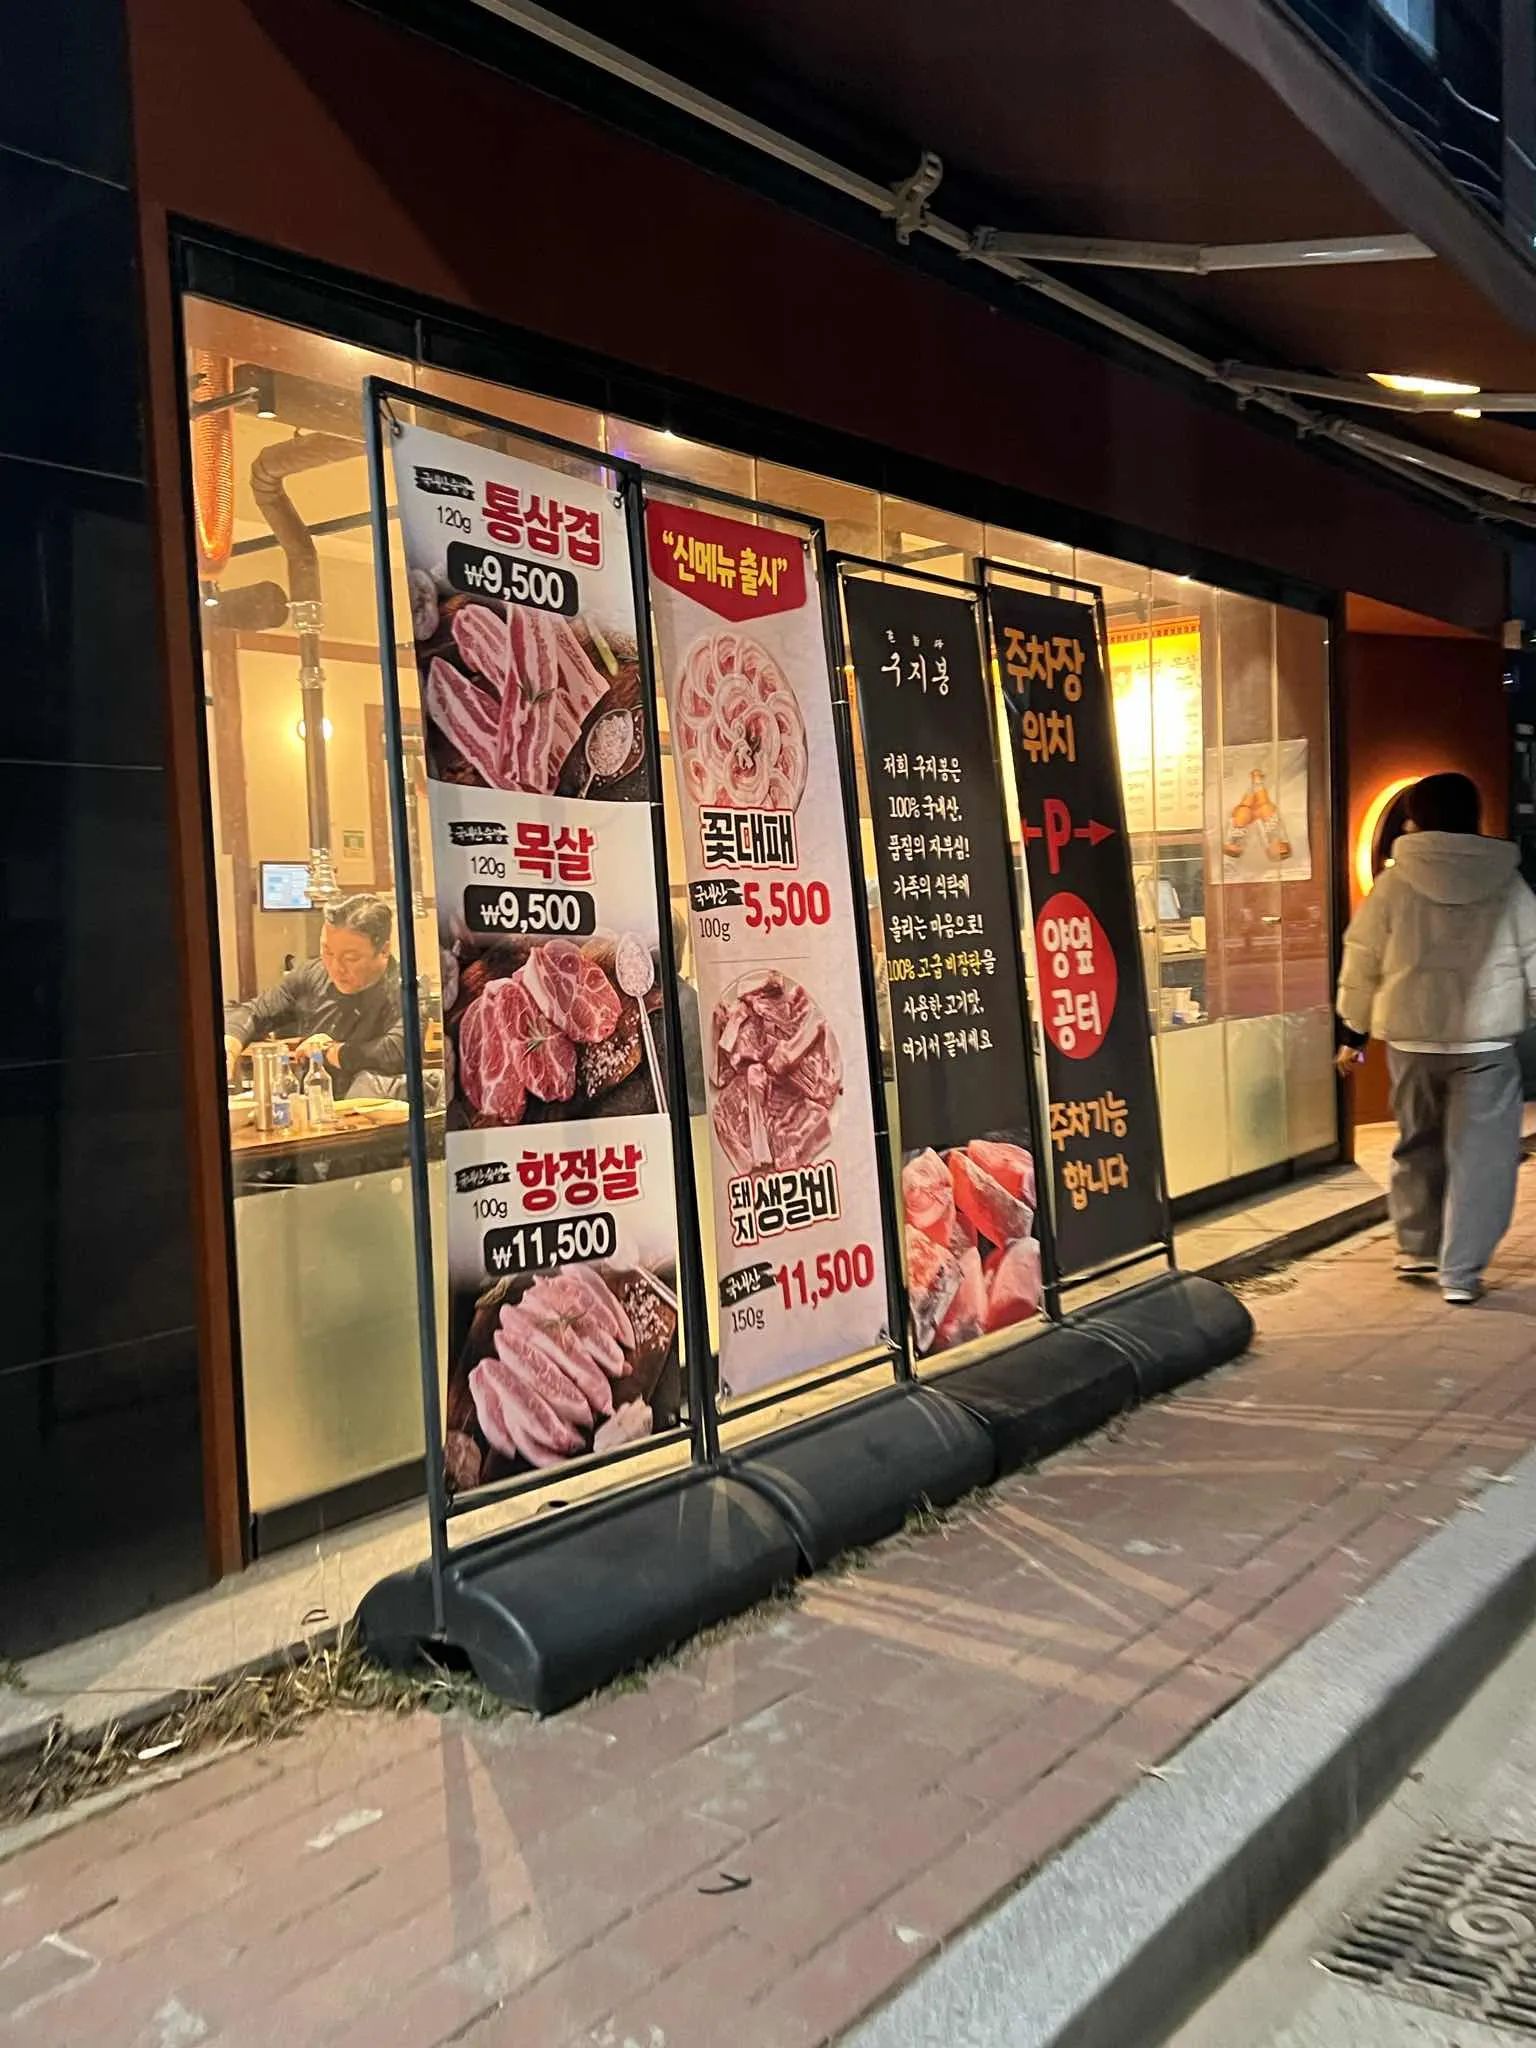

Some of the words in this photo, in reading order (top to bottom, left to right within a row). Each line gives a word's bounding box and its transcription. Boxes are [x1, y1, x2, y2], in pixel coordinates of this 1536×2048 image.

[437, 506, 472, 533] 120g
[482, 480, 601, 566] 통삼겹
[464, 555, 564, 609] ₩9,500
[880, 652, 950, 696] 구지봉
[1004, 627, 1085, 702] 주차장
[1022, 710, 1076, 763] 위치
[883, 753, 909, 781] 저희
[912, 755, 962, 784] 구지봉은
[888, 796, 920, 819] 100%
[921, 795, 963, 822] 국내산,
[513, 822, 595, 882] 목살
[703, 811, 795, 864] 꽃대패
[888, 834, 926, 862] 품질의
[929, 834, 971, 861] 자부심!
[1043, 798, 1071, 874] P
[471, 856, 506, 878] 120g
[893, 873, 932, 901] 가족의
[935, 873, 971, 900] 식탁에
[480, 891, 580, 934] ₩9,500
[694, 882, 730, 907] 국내산
[743, 881, 831, 935] 5,500
[700, 918, 731, 942] 100g
[889, 914, 927, 943] 올리는
[930, 913, 984, 940] 마음으로!
[1042, 916, 1096, 979] 양옆
[887, 958, 916, 982] 100%
[917, 953, 943, 980] 고급
[944, 949, 997, 977] 비장탄을
[902, 993, 942, 1023] 사용한
[943, 988, 985, 1016] 고기맛,
[1052, 989, 1102, 1050] 공터
[903, 1033, 941, 1063] 여기서
[943, 1028, 994, 1058] 끝내세요
[1049, 1090, 1129, 1151] 주차가능
[516, 1144, 643, 1212] 항정살
[754, 1166, 838, 1232] 생갈비
[1062, 1153, 1129, 1211] 합니다
[473, 1198, 508, 1219] 100g
[491, 1217, 611, 1270] ₩11,500
[725, 1267, 762, 1301] 국내산
[776, 1244, 875, 1311] 11,500
[731, 1307, 766, 1334] 150g
